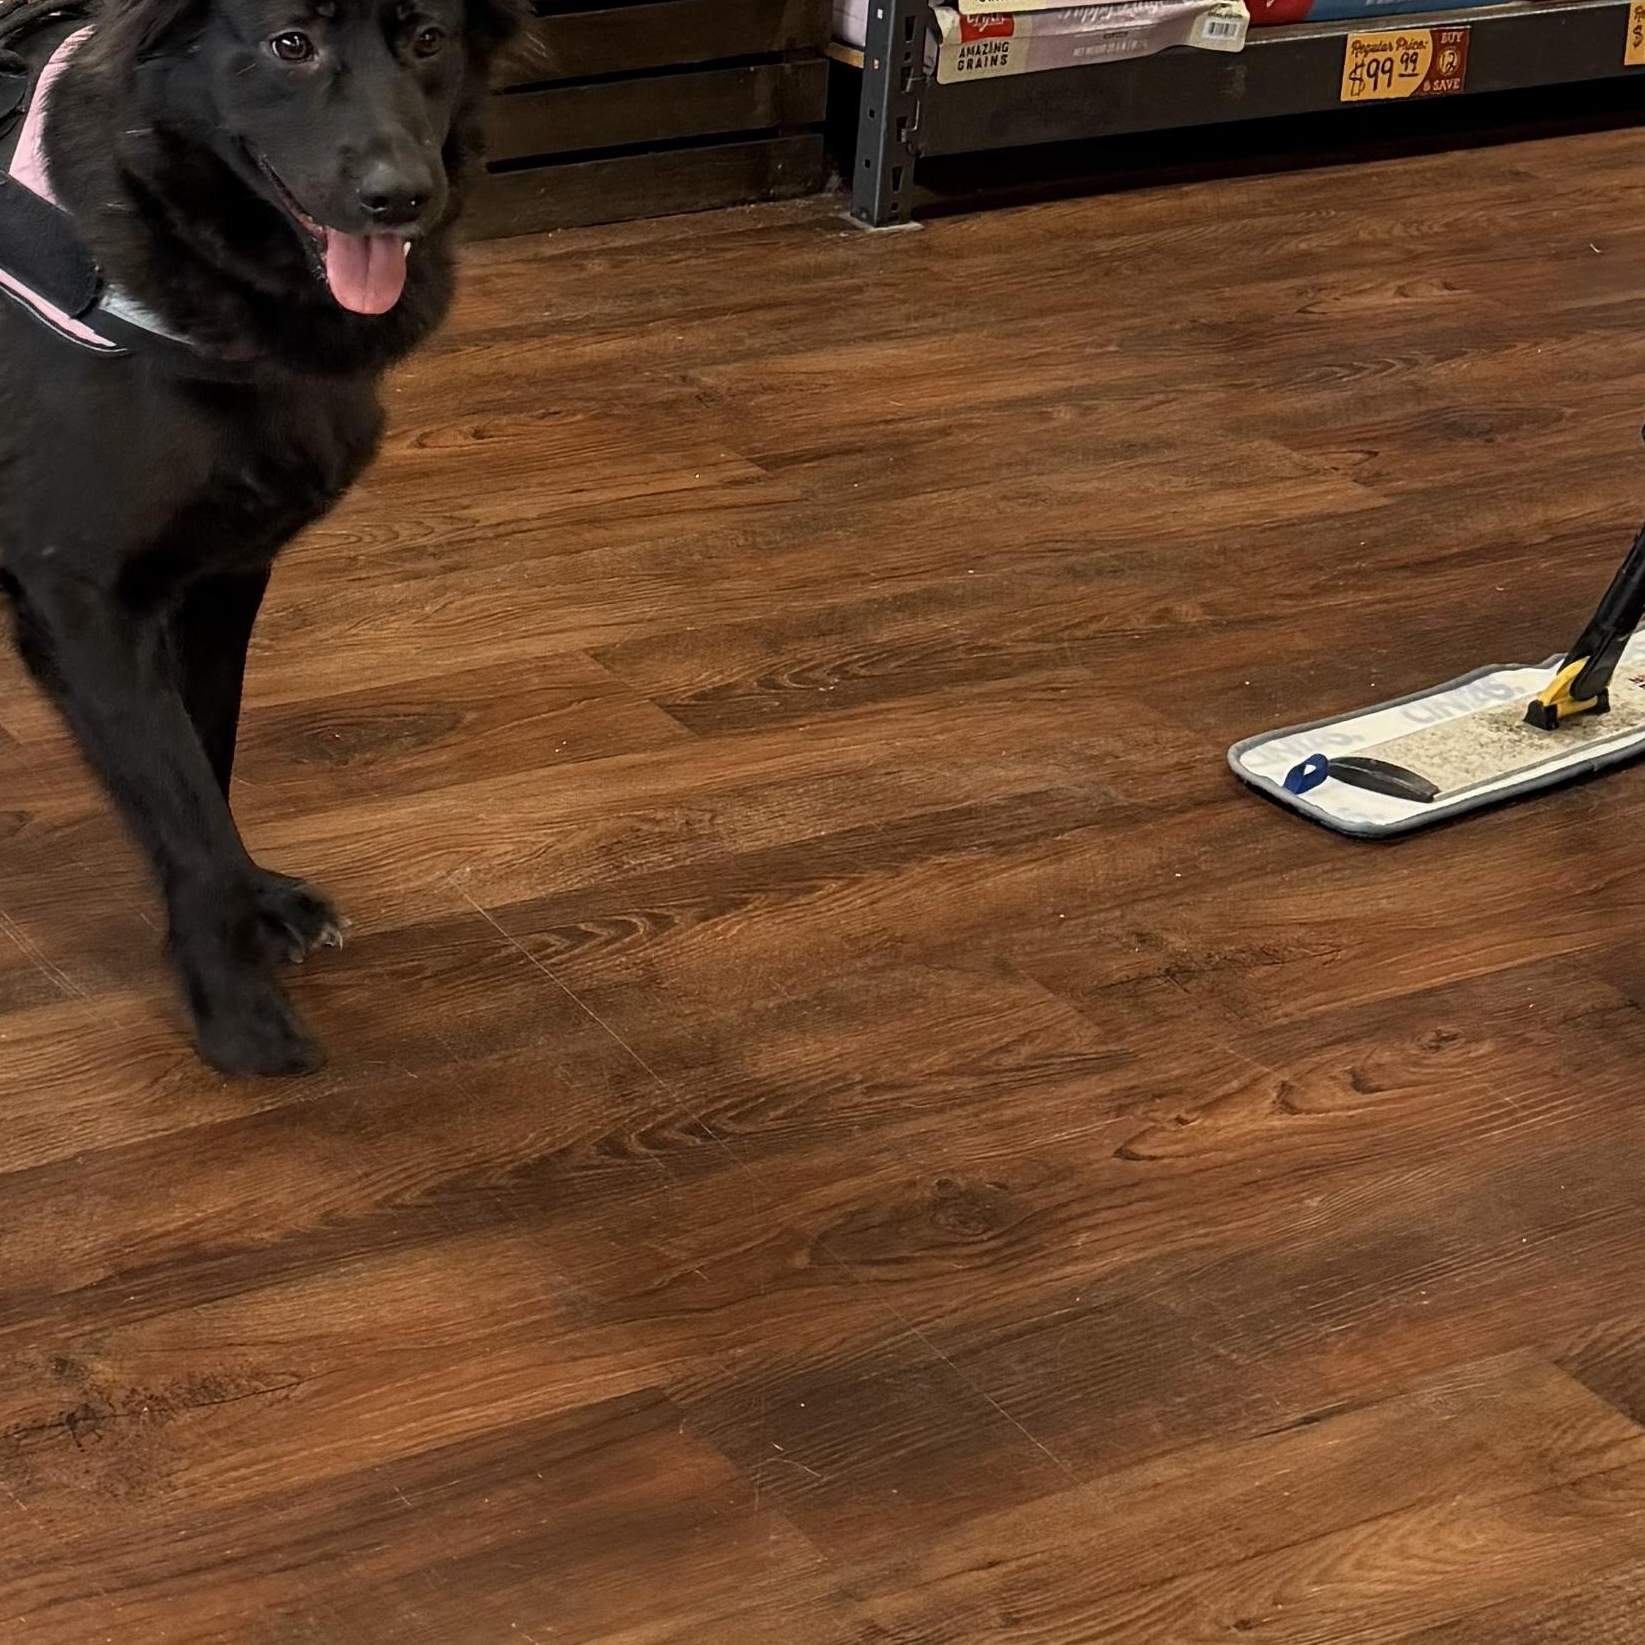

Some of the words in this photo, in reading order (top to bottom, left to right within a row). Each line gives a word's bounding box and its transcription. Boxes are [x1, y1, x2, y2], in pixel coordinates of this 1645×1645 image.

[1440, 30, 1464, 44] BUY
[958, 42, 1010, 59] AMAZING
[1350, 40, 1395, 57] Regular
[1395, 37, 1428, 53] Price:
[956, 55, 1009, 72] GRAINS
[1422, 81, 1432, 93] &
[1431, 77, 1461, 92] SAVE
